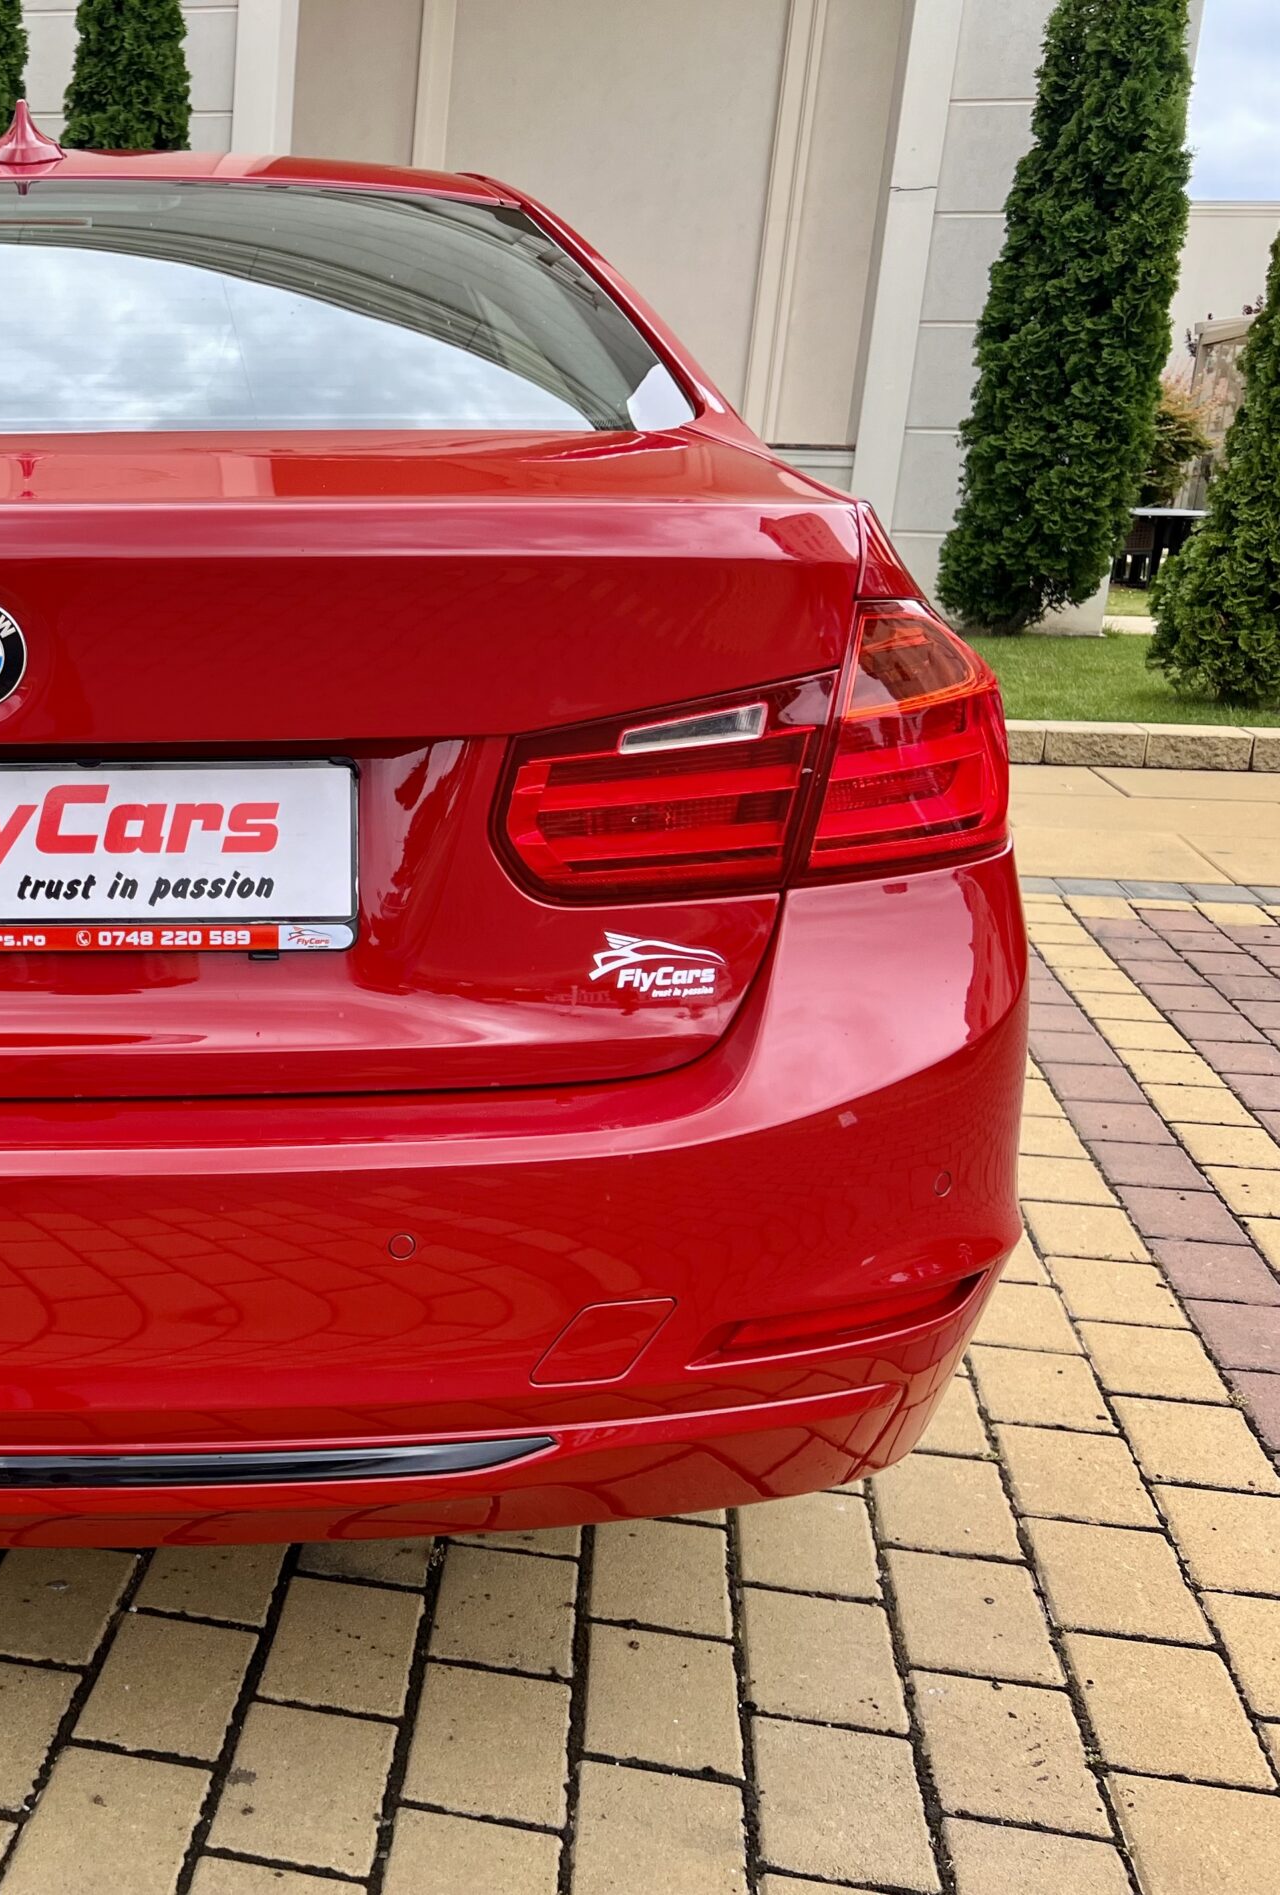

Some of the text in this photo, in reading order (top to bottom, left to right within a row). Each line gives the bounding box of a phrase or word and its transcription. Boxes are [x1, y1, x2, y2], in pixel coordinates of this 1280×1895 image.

[17, 871, 275, 906] trust in passion
[98, 930, 251, 946] 0748 220 589
[616, 966, 716, 992] FlyCars
